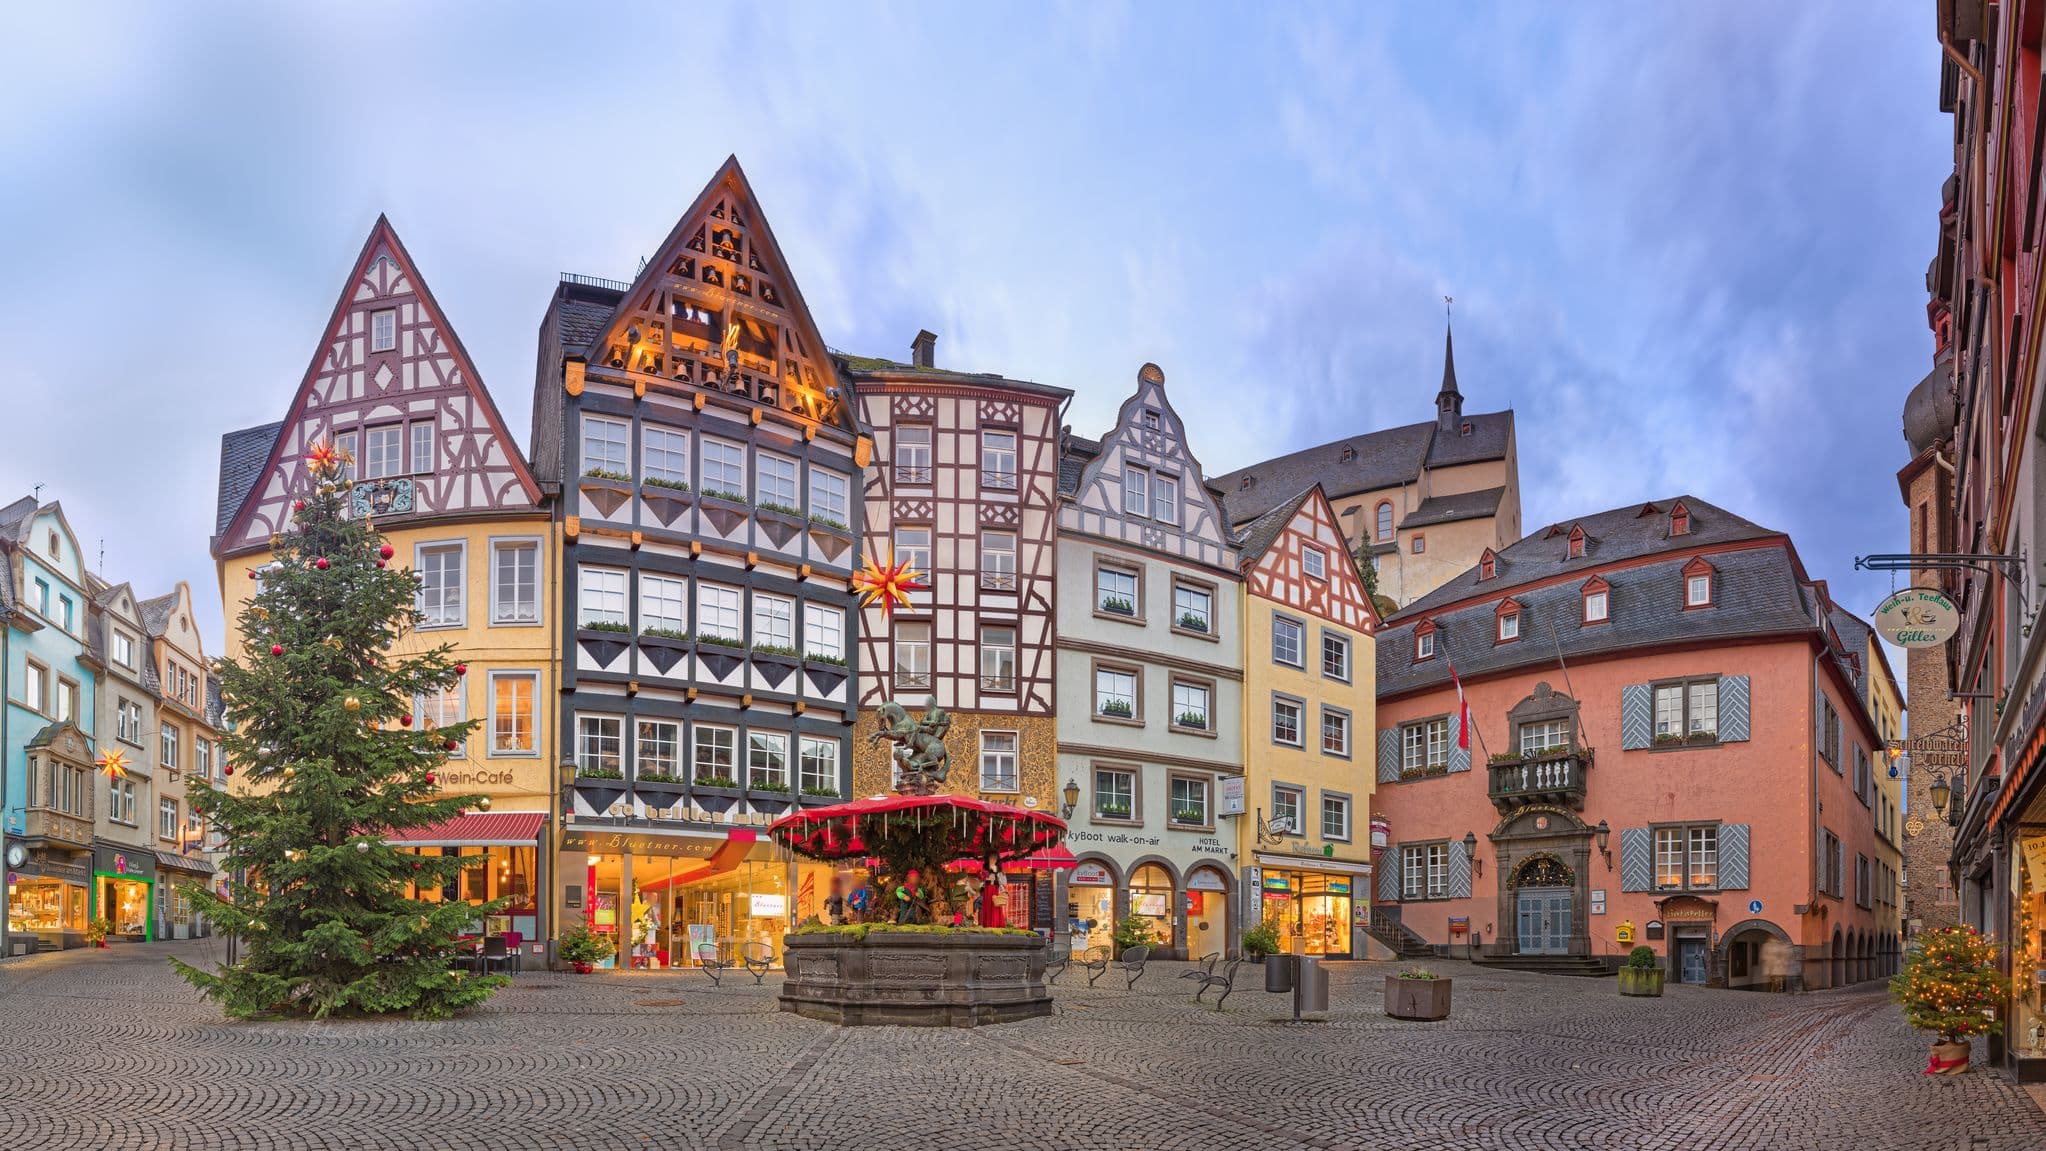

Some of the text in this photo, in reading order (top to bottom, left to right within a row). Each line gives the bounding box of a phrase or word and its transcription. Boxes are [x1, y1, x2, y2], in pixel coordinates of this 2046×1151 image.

[1896, 630, 1937, 645] Gilles
[439, 767, 514, 785] Wein-Café
[1067, 830, 1160, 845] kyBoot walk-on-air
[1199, 837, 1220, 846] HOTEL
[1191, 845, 1228, 855] AM MARKT
